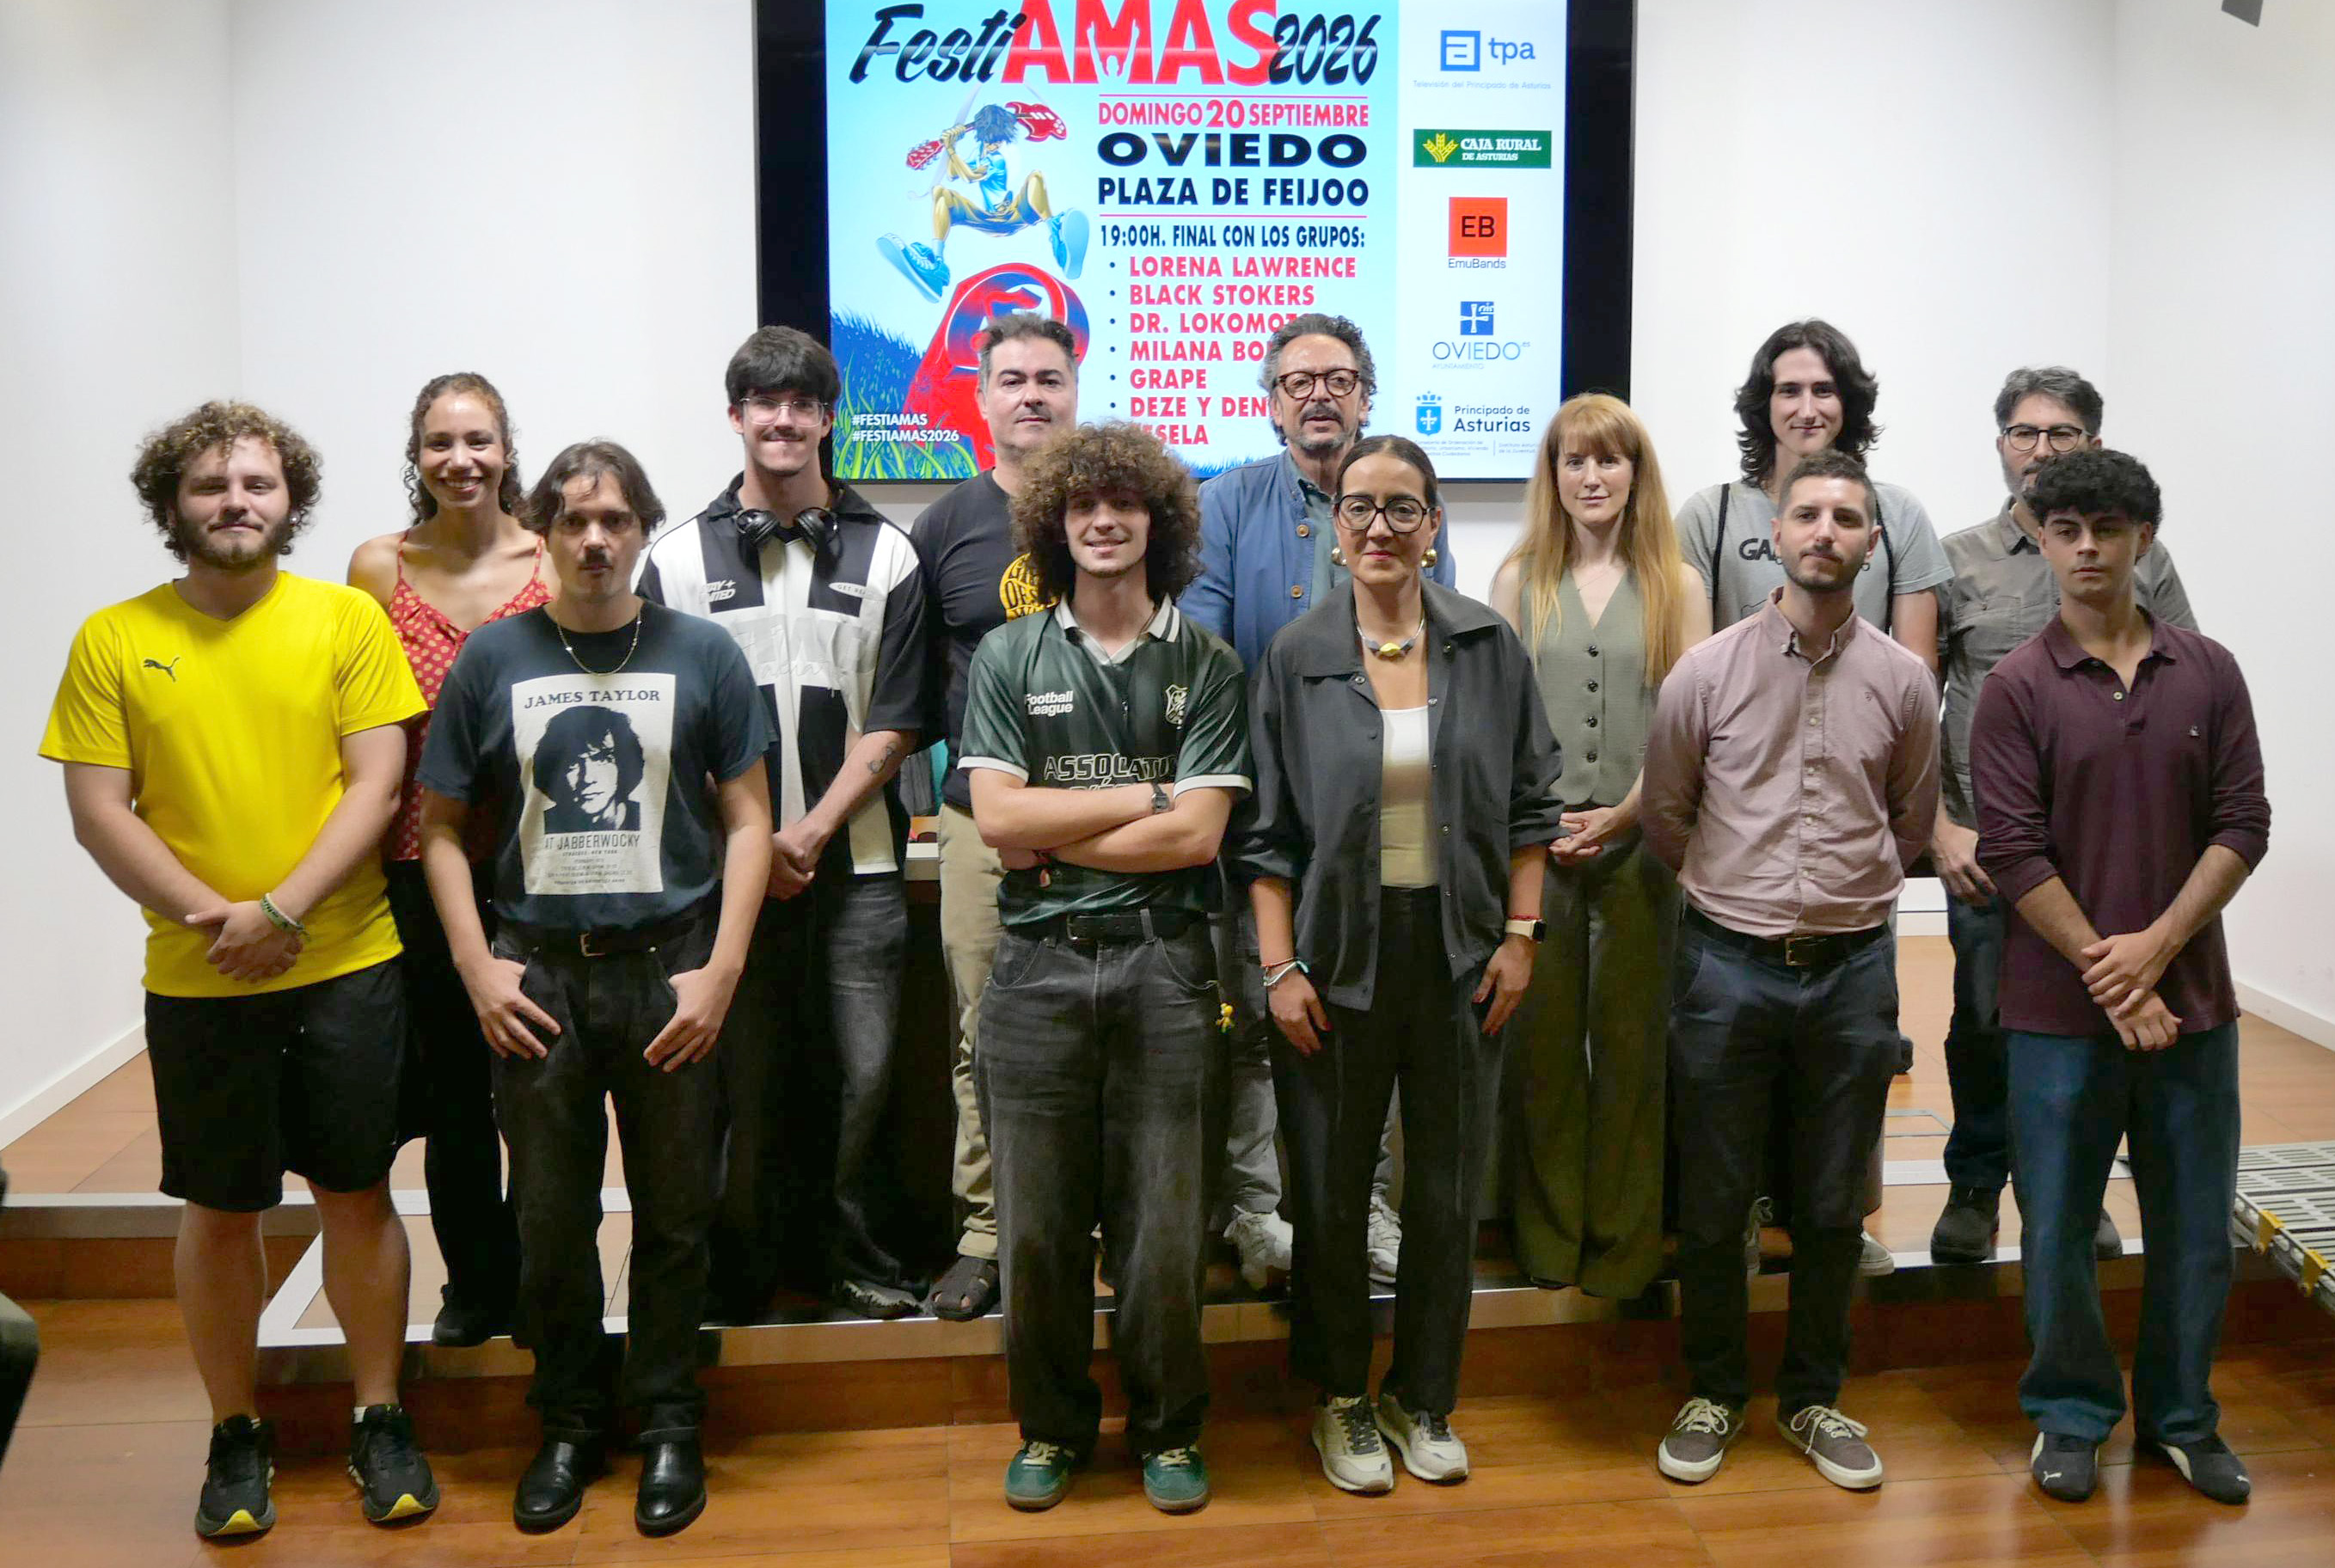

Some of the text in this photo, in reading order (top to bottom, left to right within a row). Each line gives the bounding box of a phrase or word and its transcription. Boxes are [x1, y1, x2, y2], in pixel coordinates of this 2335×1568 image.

[1268, 13, 1382, 86] 2026
[1488, 37, 1535, 65] tpa
[1099, 99, 1369, 128] DOMINGO 20 SEPTIEMBRE
[1097, 132, 1367, 168] OVIEDO
[1461, 138, 1541, 150] CAJA RURAL
[1462, 152, 1518, 161] DE ASTURIAS
[1098, 177, 1369, 206] PLAZA DE FEIJOO
[1100, 225, 1365, 248] 19:00H. FINAL CON LOS GRUPOS:
[1462, 215, 1495, 238] EB
[1130, 256, 1356, 279] LORENA LAWRENCE
[1448, 258, 1506, 269] EmuBands
[1130, 285, 1315, 306] BLACK STOKERS
[1130, 313, 1168, 334] DR.
[1130, 340, 1223, 361] MILANA
[1130, 369, 1207, 389] GRAPE
[1131, 396, 1276, 417] DEZE Y DEN
[1455, 405, 1530, 417] Principado de
[851, 413, 928, 426] #FESTIAMAS
[1453, 416, 1530, 432] Asturias
[852, 430, 959, 442] #FESTIAMAS2026
[1129, 424, 1209, 444] SELA
[1738, 537, 1777, 561] GA
[524, 689, 660, 709] JAMES TAYLOR
[1024, 690, 1074, 705] Football
[1027, 703, 1074, 717] League
[557, 833, 640, 850] JABBERWOCKY
